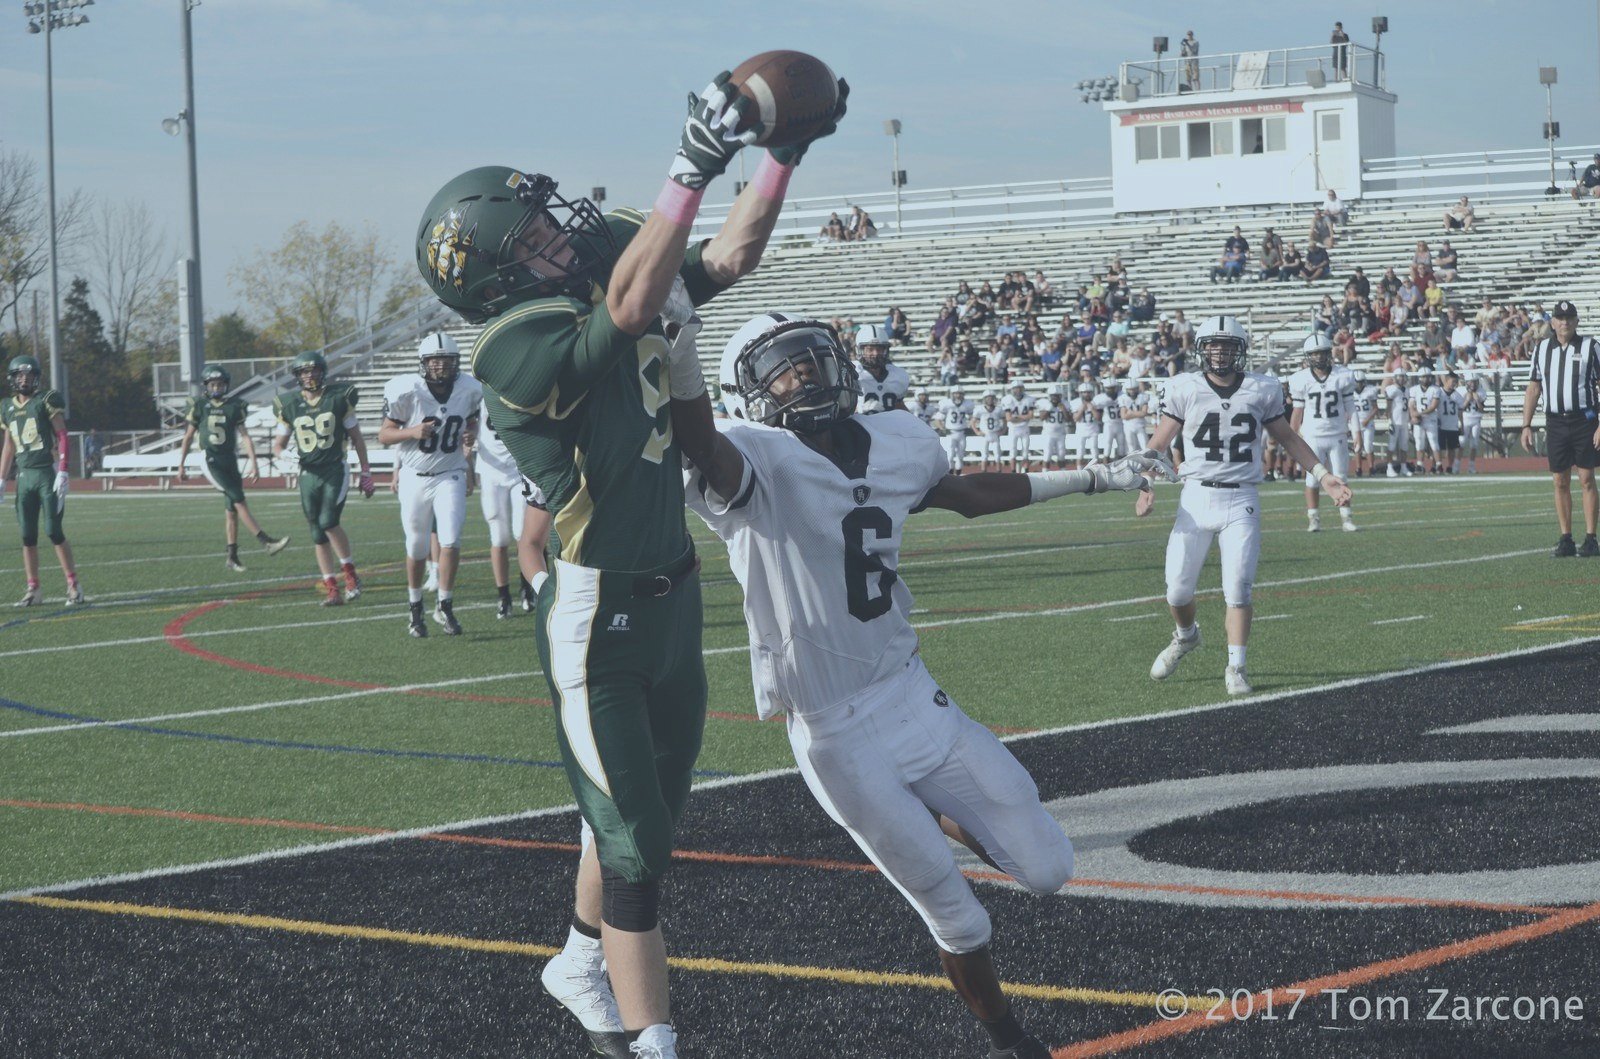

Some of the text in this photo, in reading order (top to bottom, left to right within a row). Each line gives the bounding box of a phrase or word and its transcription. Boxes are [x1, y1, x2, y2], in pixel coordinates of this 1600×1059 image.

[1138, 112, 1161, 122] JOHN
[1205, 105, 1253, 117] MEMORIAL
[1257, 103, 1283, 113] FIELD
[950, 411, 967, 425] 37
[1308, 390, 1340, 418] 72
[1443, 400, 1457, 416] 13
[9, 417, 44, 454] 14
[207, 414, 227, 446] 5
[293, 411, 336, 454] 69
[1191, 412, 1258, 463] 42
[842, 506, 898, 623] 6
